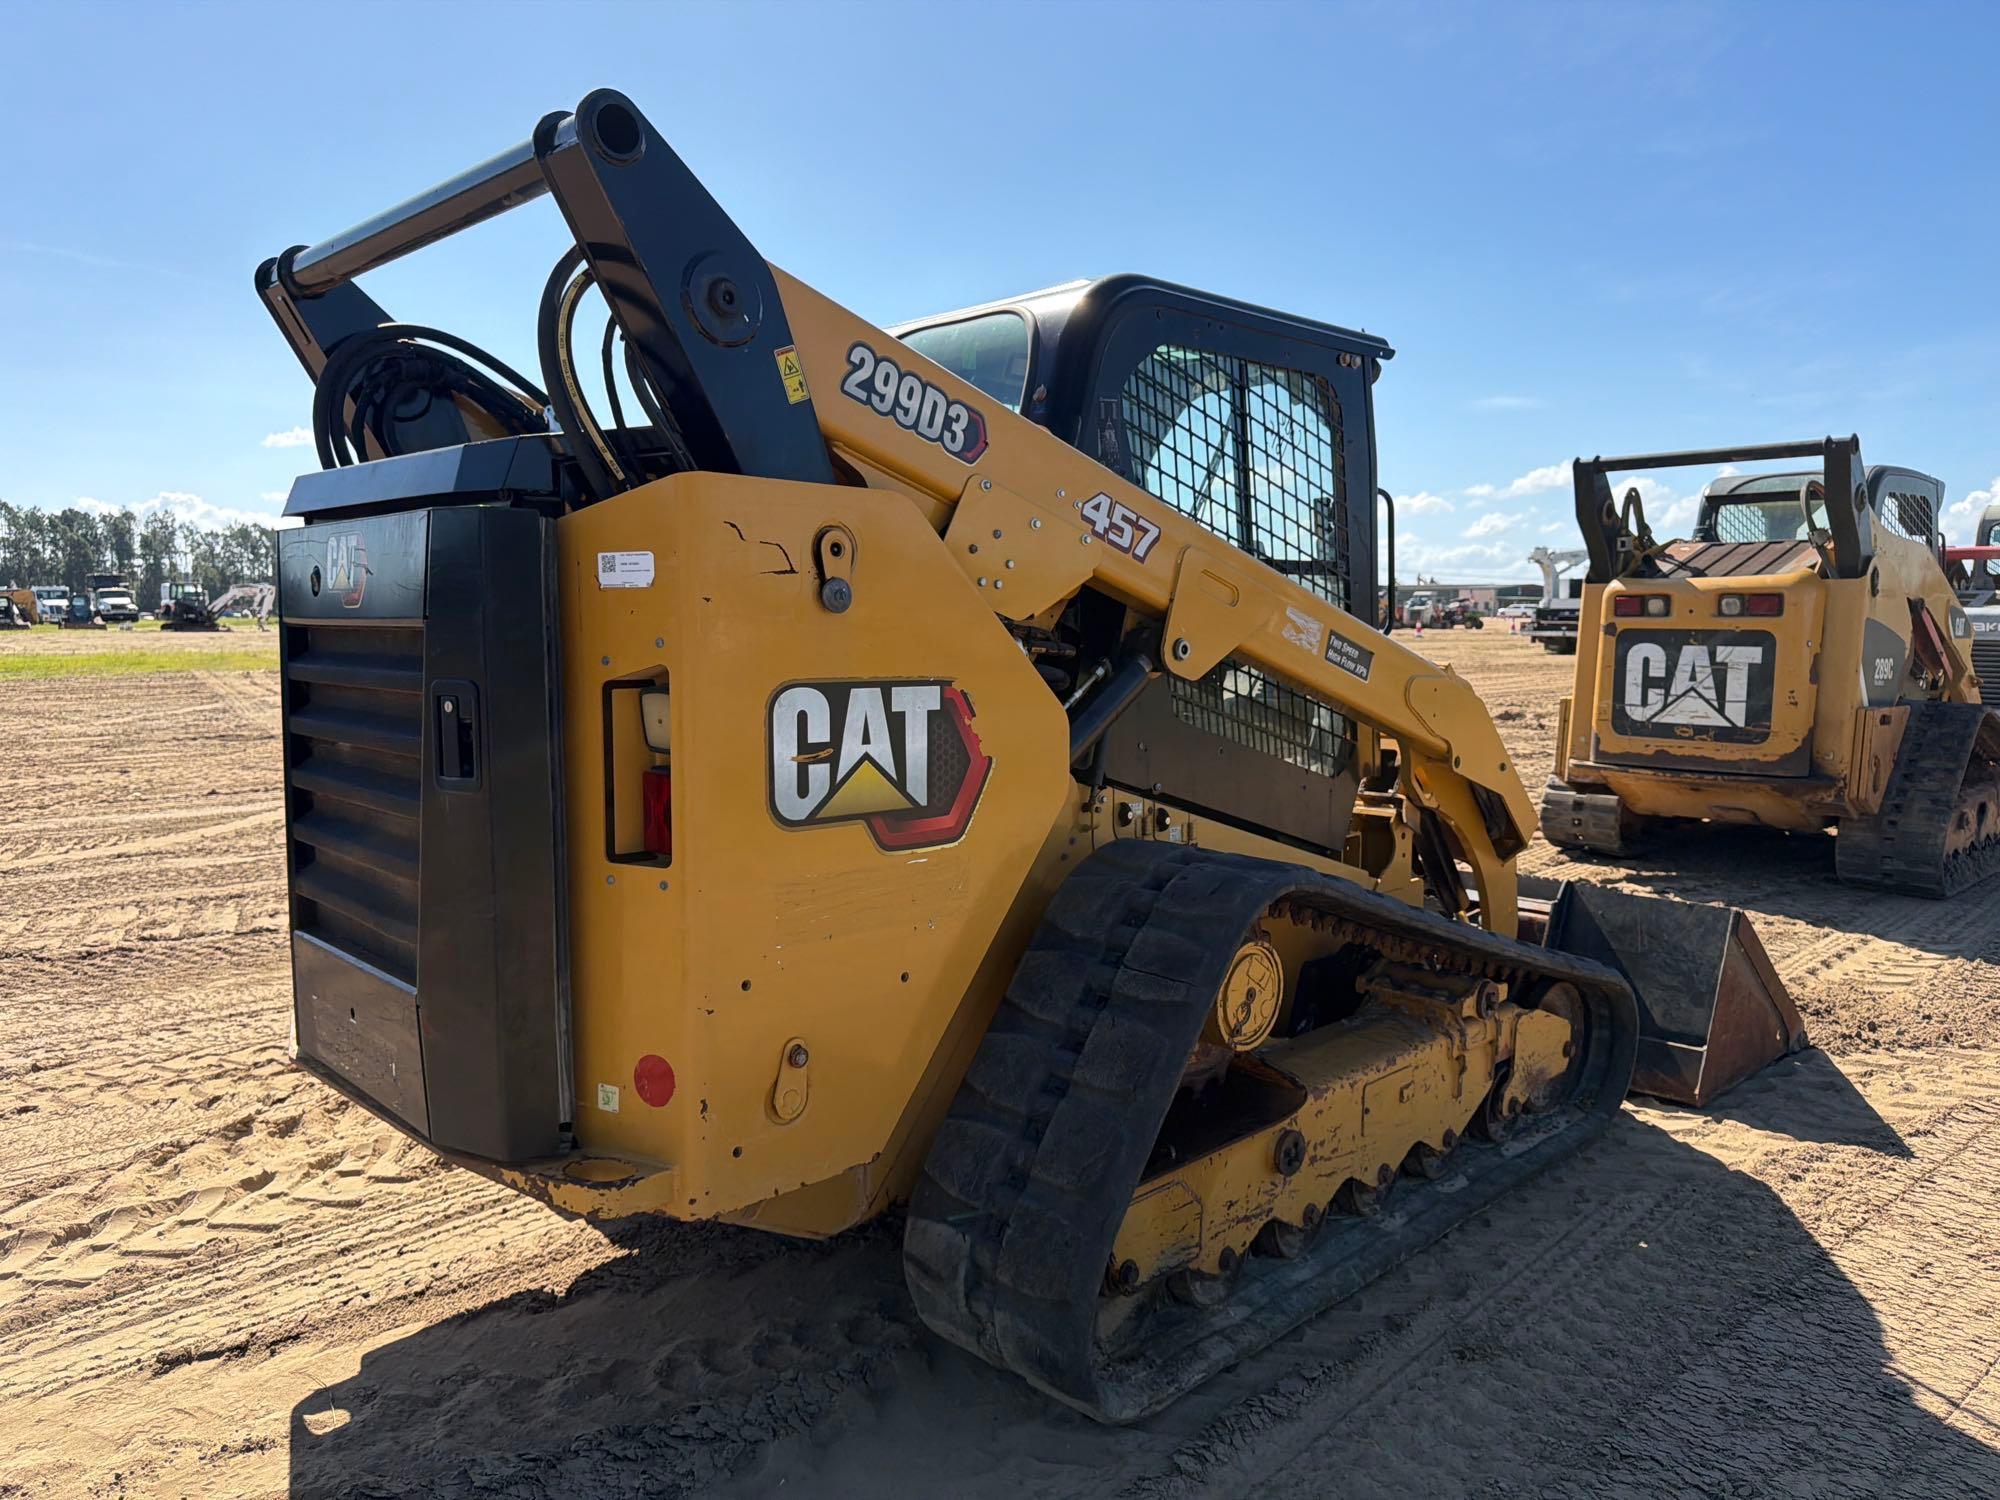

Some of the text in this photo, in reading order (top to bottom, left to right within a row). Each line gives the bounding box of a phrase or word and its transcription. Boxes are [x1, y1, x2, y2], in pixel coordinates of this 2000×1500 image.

[844, 346, 969, 452] 299D3
[327, 535, 358, 590] CAT
[1081, 492, 1161, 563] 457
[1625, 643, 1763, 728] CAT
[1874, 657, 1894, 680] 289C
[773, 685, 941, 821] CAT
